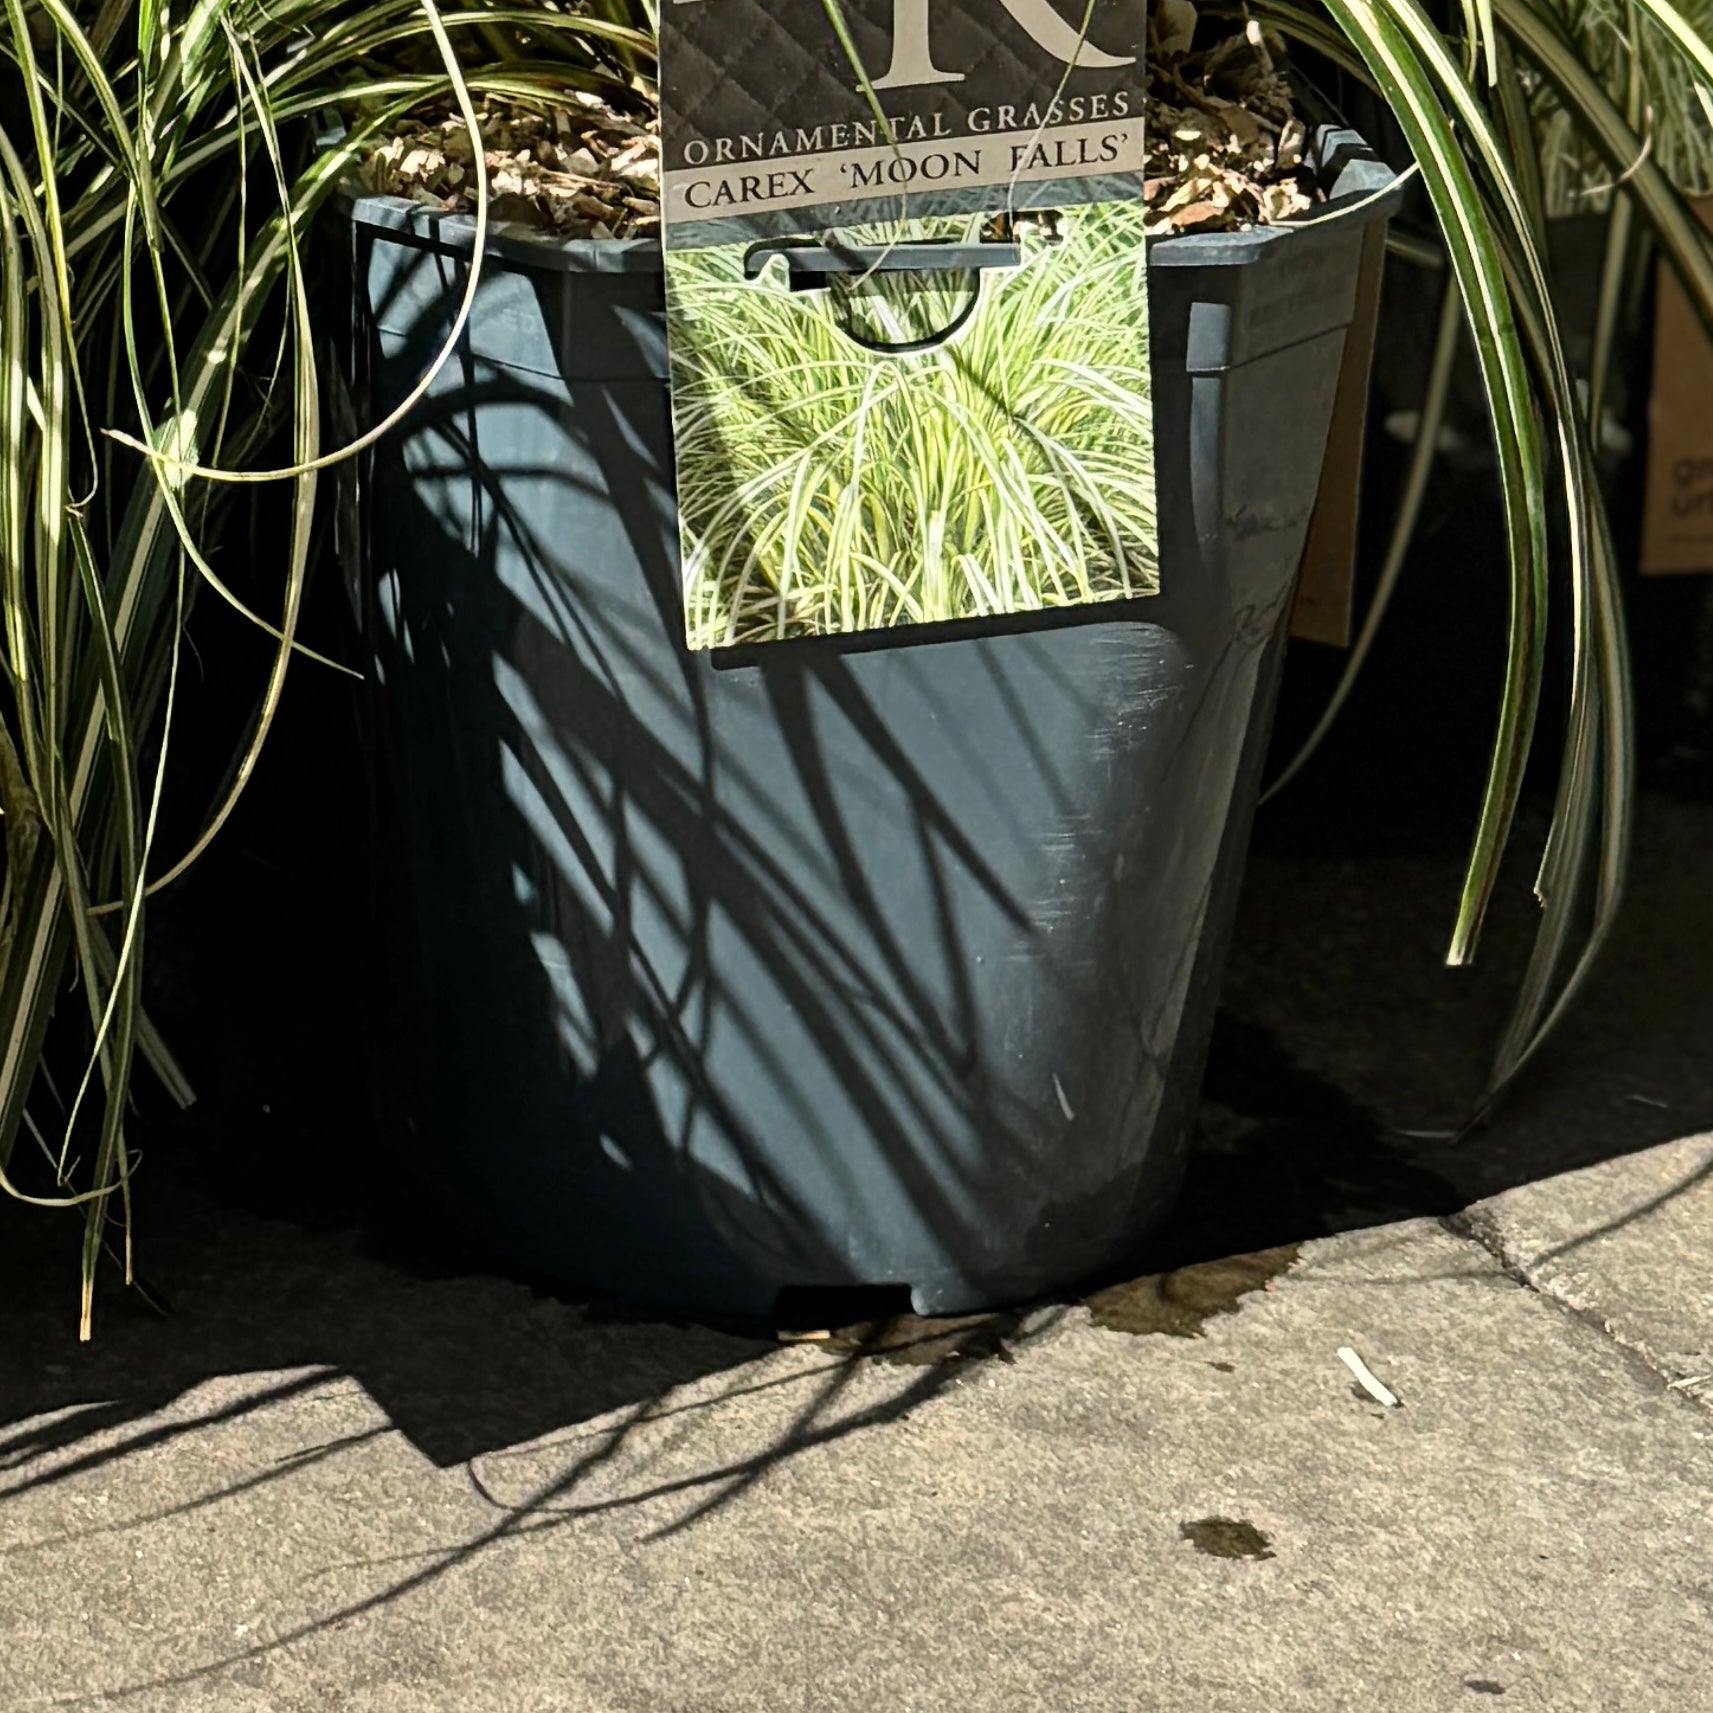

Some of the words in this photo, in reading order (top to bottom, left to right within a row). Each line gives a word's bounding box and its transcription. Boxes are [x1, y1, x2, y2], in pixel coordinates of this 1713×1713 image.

[683, 111, 952, 166] ORNAMENTAL
[967, 91, 1129, 133] GRASSES
[684, 167, 816, 209] CAREX
